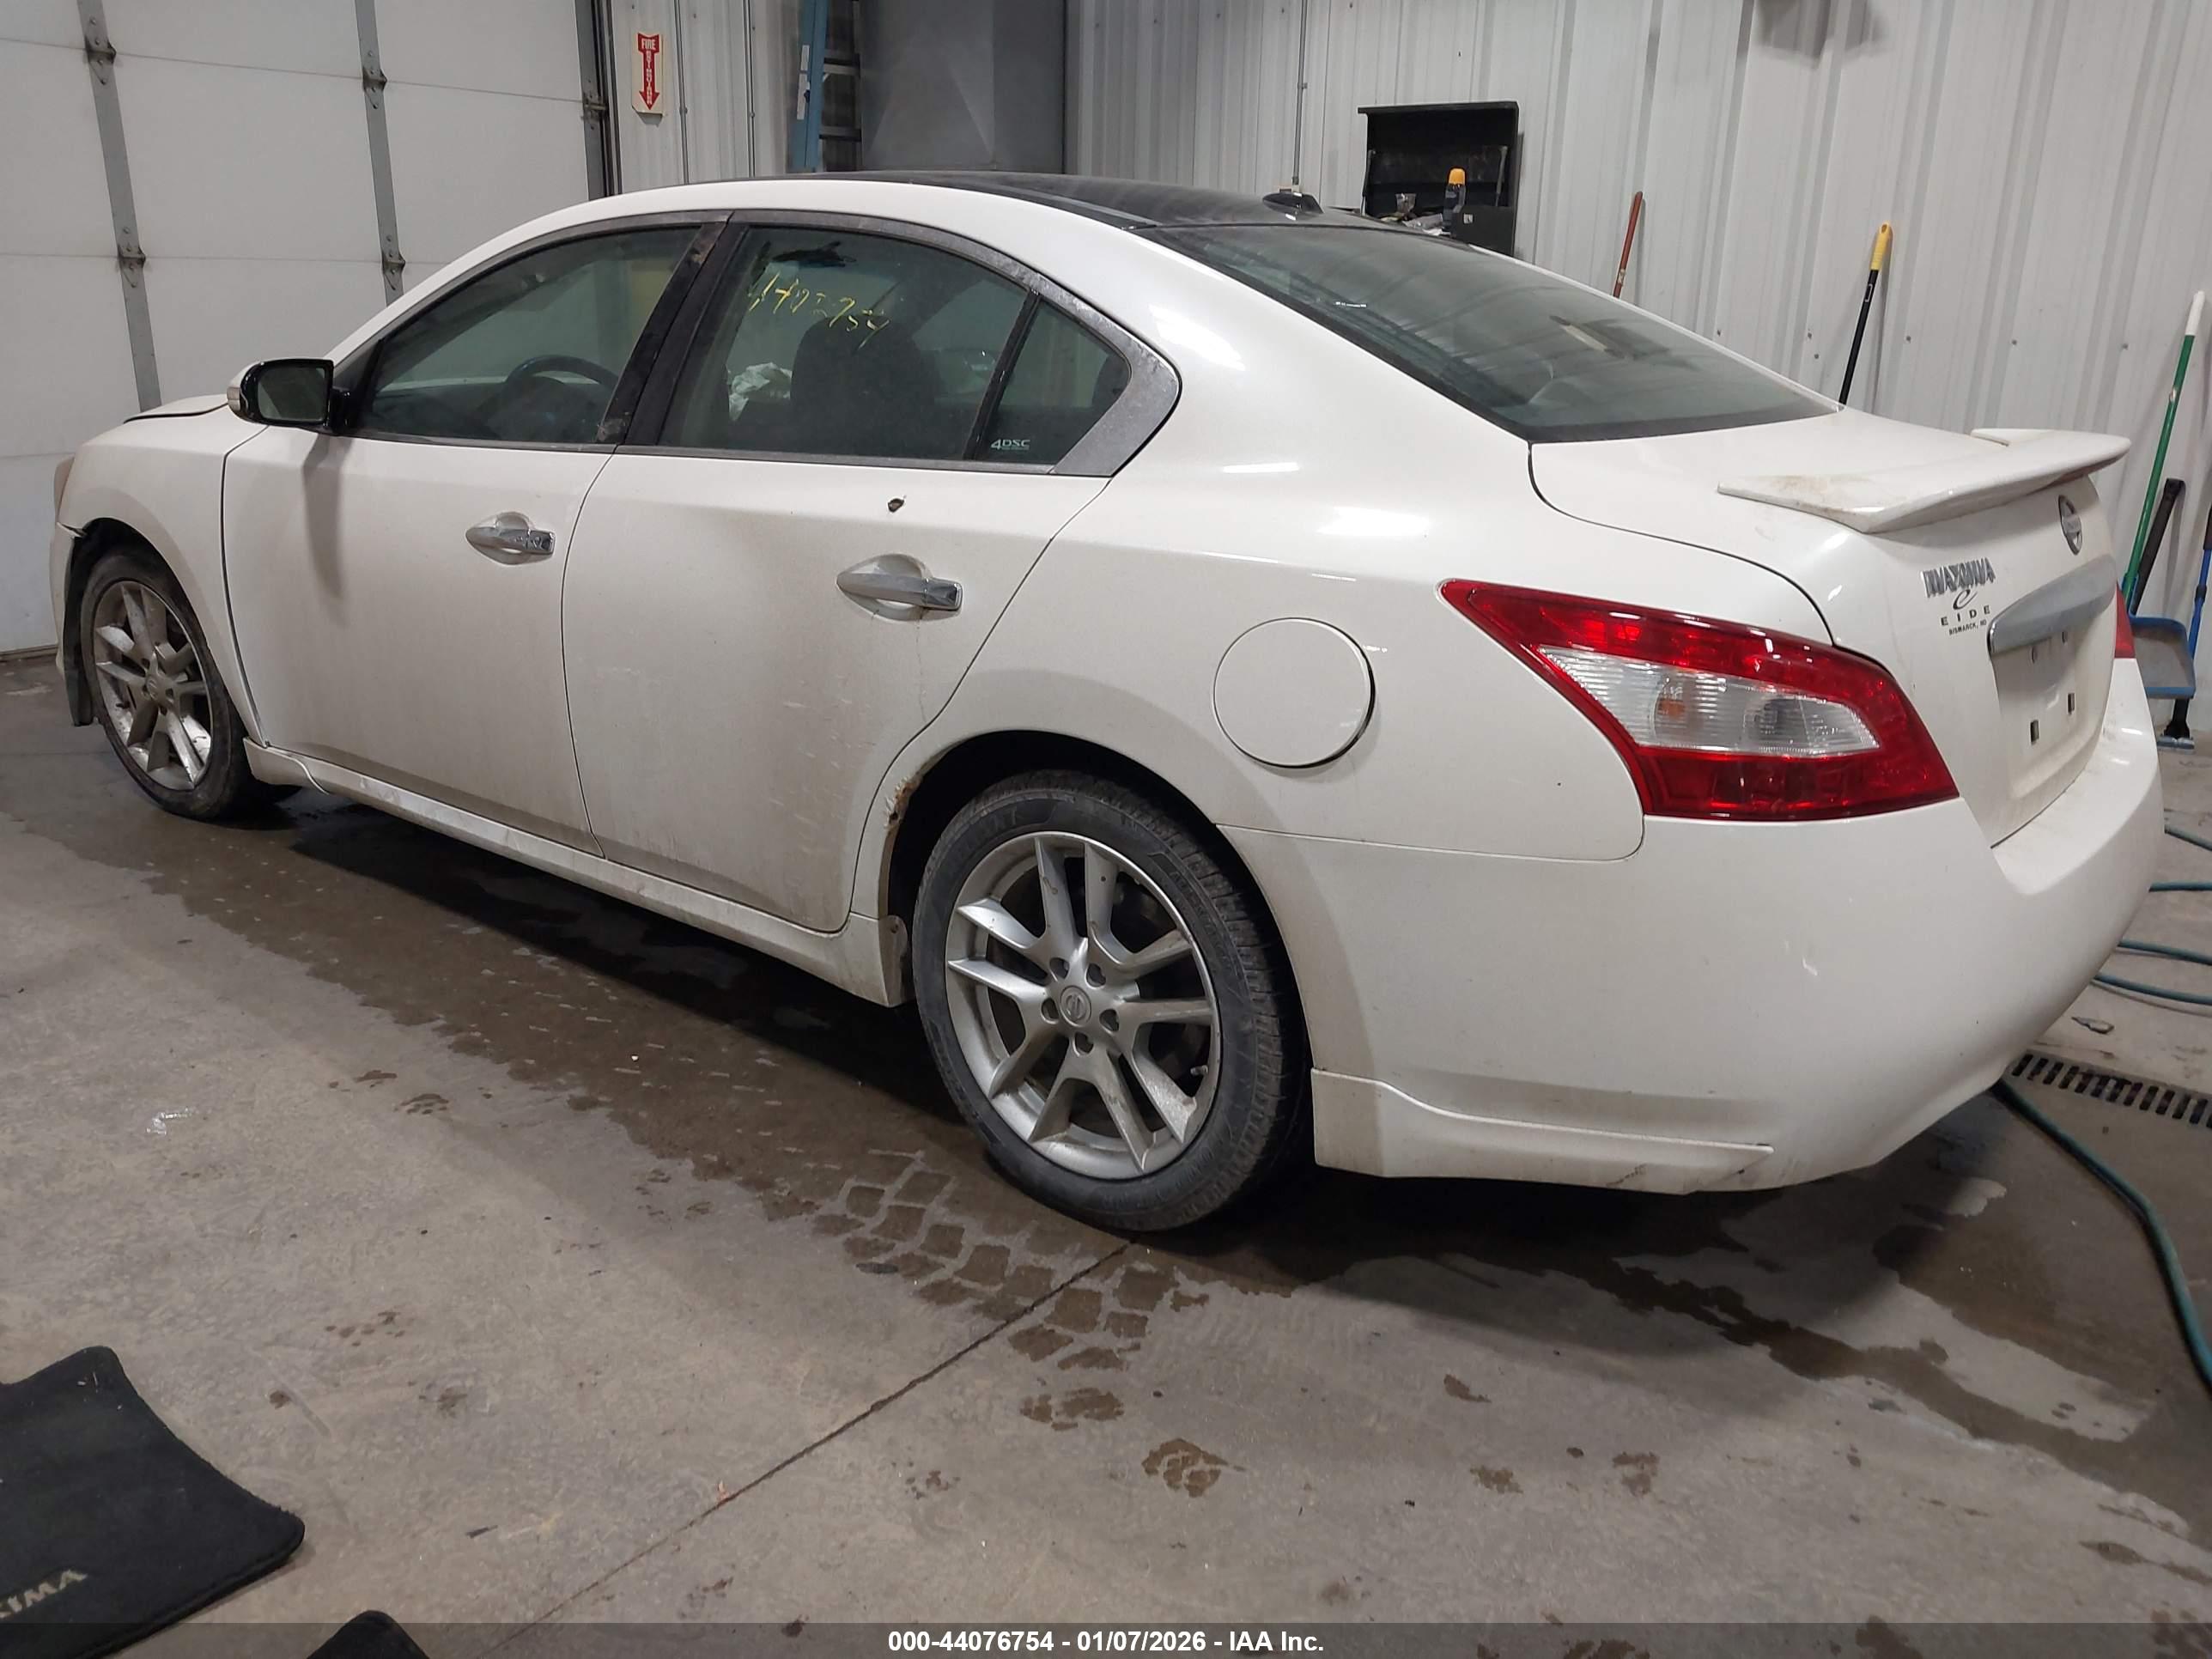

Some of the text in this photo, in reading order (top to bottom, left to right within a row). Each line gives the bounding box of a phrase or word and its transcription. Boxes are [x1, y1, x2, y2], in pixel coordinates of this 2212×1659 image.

[641, 38, 656, 51] FIRE
[1919, 556, 1996, 599] MAXIMA
[1940, 605, 1990, 626] EIDE
[1948, 622, 1978, 635] BISMARCK,
